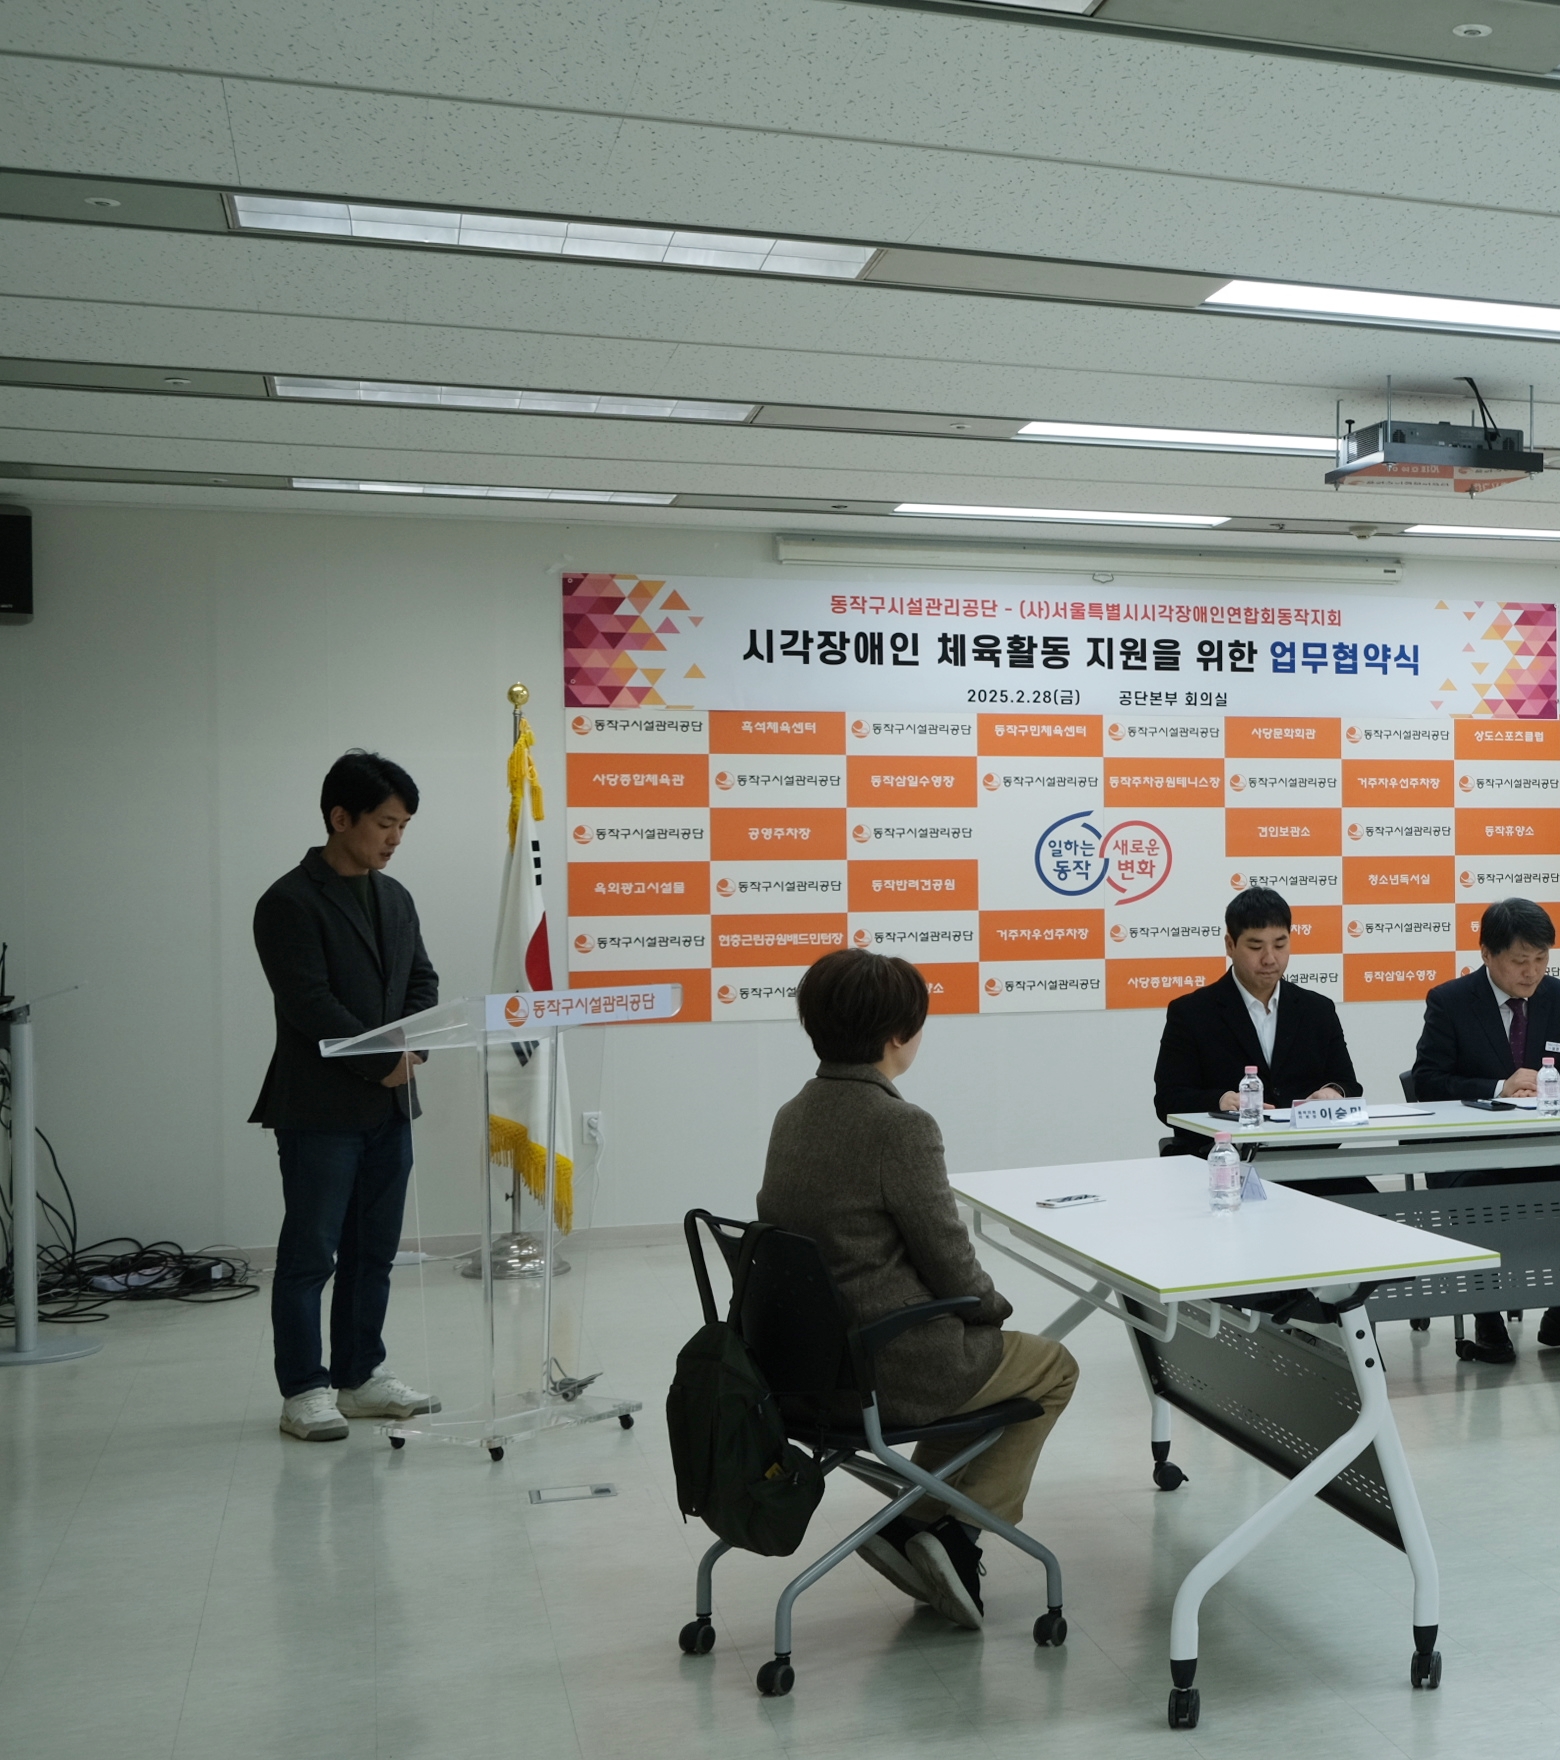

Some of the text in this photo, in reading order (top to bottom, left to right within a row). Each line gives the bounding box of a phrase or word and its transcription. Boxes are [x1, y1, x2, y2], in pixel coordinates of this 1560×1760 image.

[831, 594, 999, 619] 동작구시설관리공단
[1019, 600, 1342, 627] (사)서울특별시시각장애인연합회동작지회
[742, 628, 1419, 676] 시각장애인 체육활동 지원을 위한 업무협약식
[967, 689, 1080, 706] 2025.2.28(금)
[1119, 690, 1227, 707] 공단본부 회의실
[594, 719, 703, 733] 동작구시설관리공단
[741, 720, 817, 735] 흑석체육센터
[872, 723, 972, 736] 동작구시설관리공단
[994, 724, 1087, 738] 동작구민체육센터
[1127, 726, 1220, 739] 동작구시설관리공단
[1251, 727, 1317, 740] 사당문화회관
[1364, 729, 1450, 741] 동작구시설관리공단
[1474, 730, 1544, 743] 상도스포츠클럽
[592, 773, 685, 787] 사당종합체육관
[737, 774, 841, 787] 동작구시설관리공단
[870, 775, 956, 788] 동작삼일수영장
[1002, 776, 1099, 788] 동작구시설관리공단
[1109, 776, 1221, 789] 동작주차공원테니스장
[1248, 777, 1337, 789] 동작구시설관리공단
[1357, 777, 1441, 790] 거주자우선주차장
[1476, 778, 1560, 790] 동작구시설관리공단
[595, 828, 704, 841] 동작구시설관리공단
[748, 827, 812, 841] 공영주차장
[873, 827, 973, 840] 동작구시설관리공단
[1257, 826, 1311, 838] 견인보관소
[1365, 826, 1452, 838] 동작구시설관리공단
[1484, 825, 1535, 838] 동작휴양소
[1048, 839, 1096, 858] 일하는
[1113, 839, 1160, 857] 새로운
[1052, 859, 1092, 882] 동작
[1117, 859, 1156, 881] 변화
[871, 878, 956, 893] 동작반려견공원
[1249, 875, 1338, 887] 동작구시설관리공단
[1368, 873, 1431, 886] 청소년독서실
[1477, 872, 1560, 885] 동작구시설관리공단
[594, 881, 686, 896] 옥외광고시설물
[738, 880, 842, 894] 동작구시설관리공단
[996, 927, 1090, 941] 거주자우선주차장
[1129, 925, 1222, 939] 동작구시설관리공단
[1365, 921, 1452, 934] 동작구시설관리공단
[597, 935, 706, 950] 동작구시설관리공단
[718, 932, 844, 948] 현충근린공원배드민턴장
[874, 930, 974, 944] 동작구시설관리공단
[1127, 975, 1206, 989] 사당종합체육관
[1282, 973, 1338, 984] 시설관리공단
[1363, 969, 1437, 983] 동작삼일수영장
[739, 986, 797, 999] 동작구시설
[1004, 978, 1101, 993] 동작구시설관리공단
[533, 993, 656, 1018] 동작구시설관리공단
